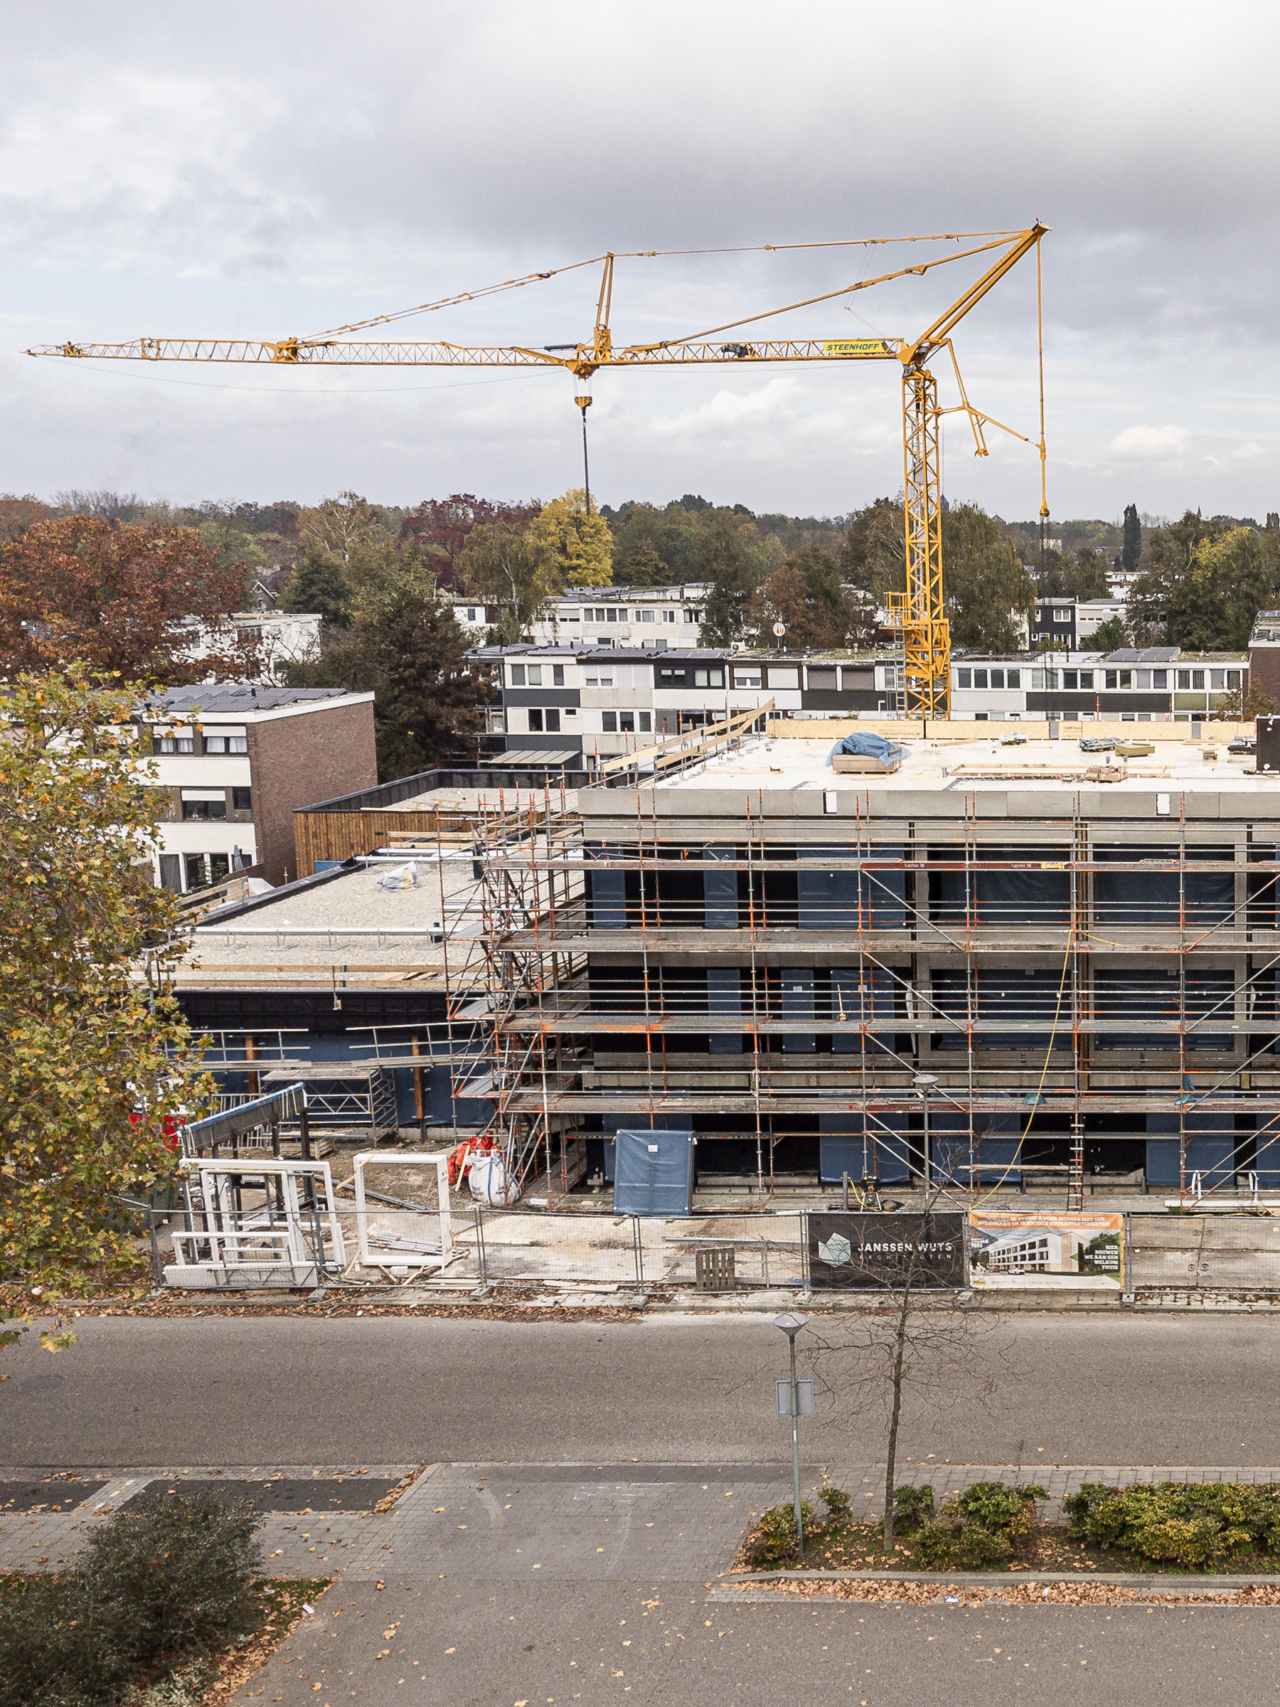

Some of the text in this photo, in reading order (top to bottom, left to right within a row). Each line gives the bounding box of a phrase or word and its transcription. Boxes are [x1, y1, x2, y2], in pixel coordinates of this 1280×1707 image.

[826, 343, 880, 351] STEENHOFF
[857, 1242, 953, 1252] JANSSEN WUTS
